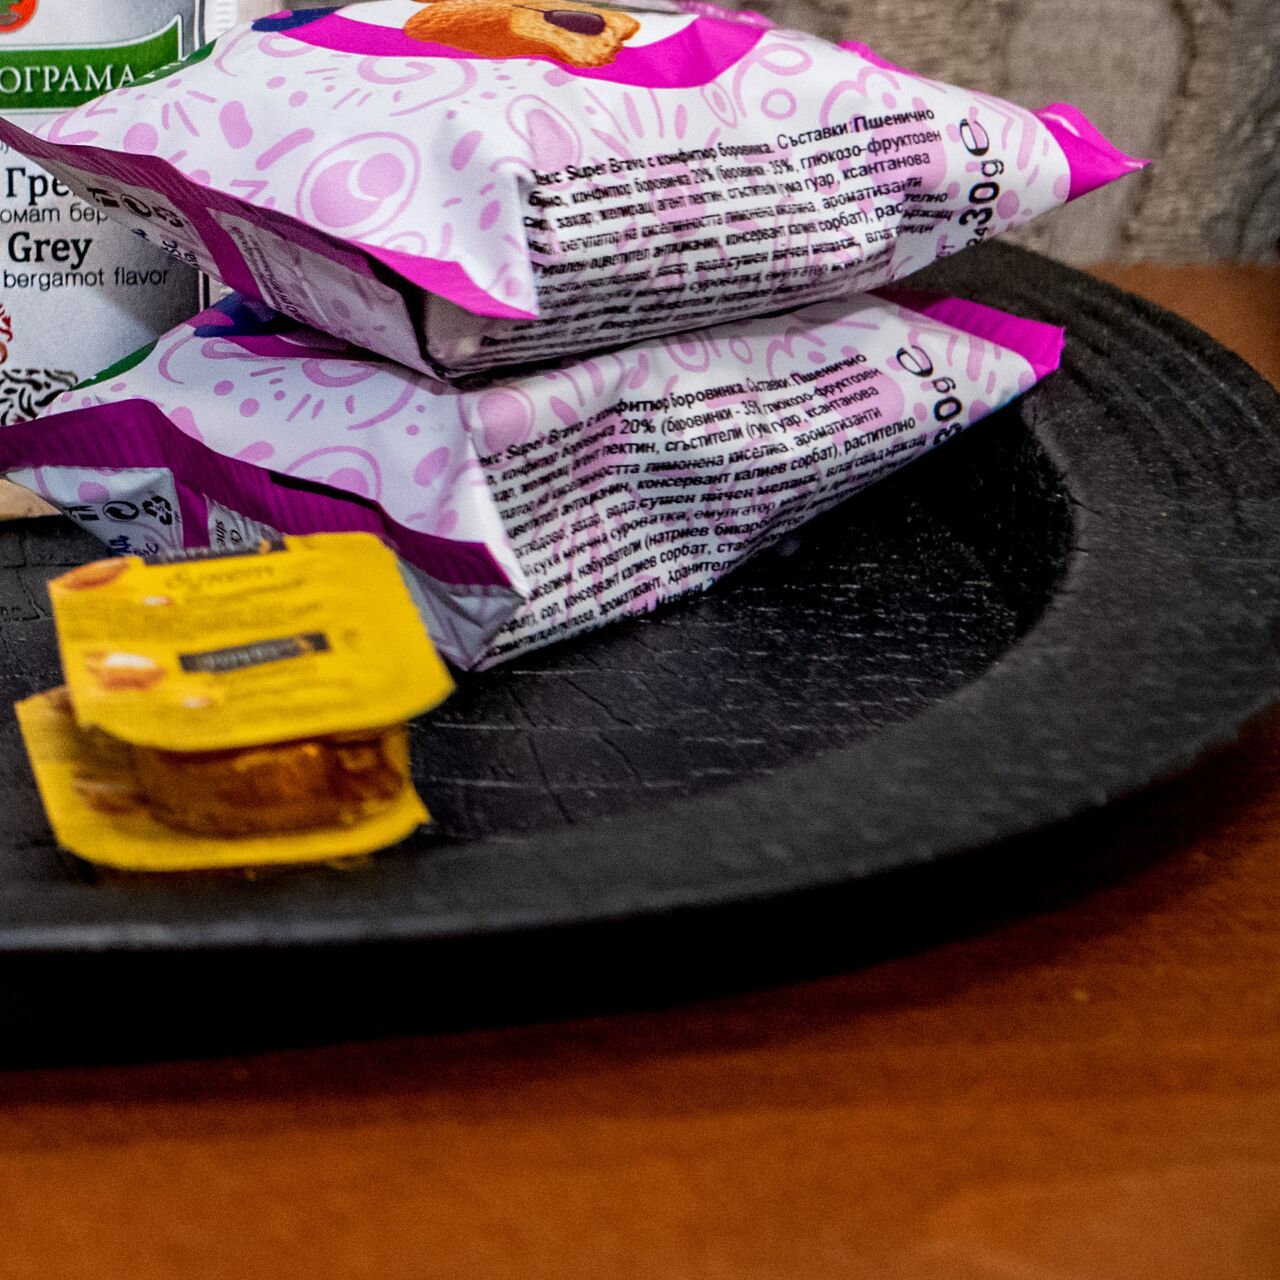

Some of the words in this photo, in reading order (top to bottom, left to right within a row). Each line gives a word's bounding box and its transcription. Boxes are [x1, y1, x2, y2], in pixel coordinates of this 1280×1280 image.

[565, 164, 606, 181] Super
[609, 158, 646, 173] Bravo
[657, 147, 717, 166] конфитюр
[777, 120, 852, 150] Съставки:
[854, 109, 935, 133] Пшенично
[800, 130, 942, 171] глюкозо-фруктозен
[6, 167, 78, 206] Гре
[657, 195, 687, 212] агент
[804, 173, 839, 196] гуар,
[842, 152, 931, 181] ксантанова
[958, 159, 1003, 225] 30g
[820, 206, 873, 233] сорбат),
[876, 192, 948, 220] растелно
[8, 234, 92, 271] Grey
[3, 270, 104, 294] bergamot
[113, 267, 169, 288] flavor
[791, 353, 867, 386] Пшенично
[602, 439, 661, 457] пектин,
[665, 429, 744, 453] сгъстители
[772, 412, 807, 435] гуар,
[807, 385, 879, 418] ксантанова
[620, 418, 656, 435] 20%
[763, 368, 883, 413] глюкозо-фруктозен
[795, 407, 882, 447] ароматизанти
[507, 514, 559, 538] цветител
[636, 472, 731, 491] консервант
[734, 463, 787, 482] калиев
[790, 445, 843, 471] сорбат),
[845, 417, 916, 453] растително
[644, 524, 708, 550] (натриев
[660, 542, 713, 564] сорбат,
